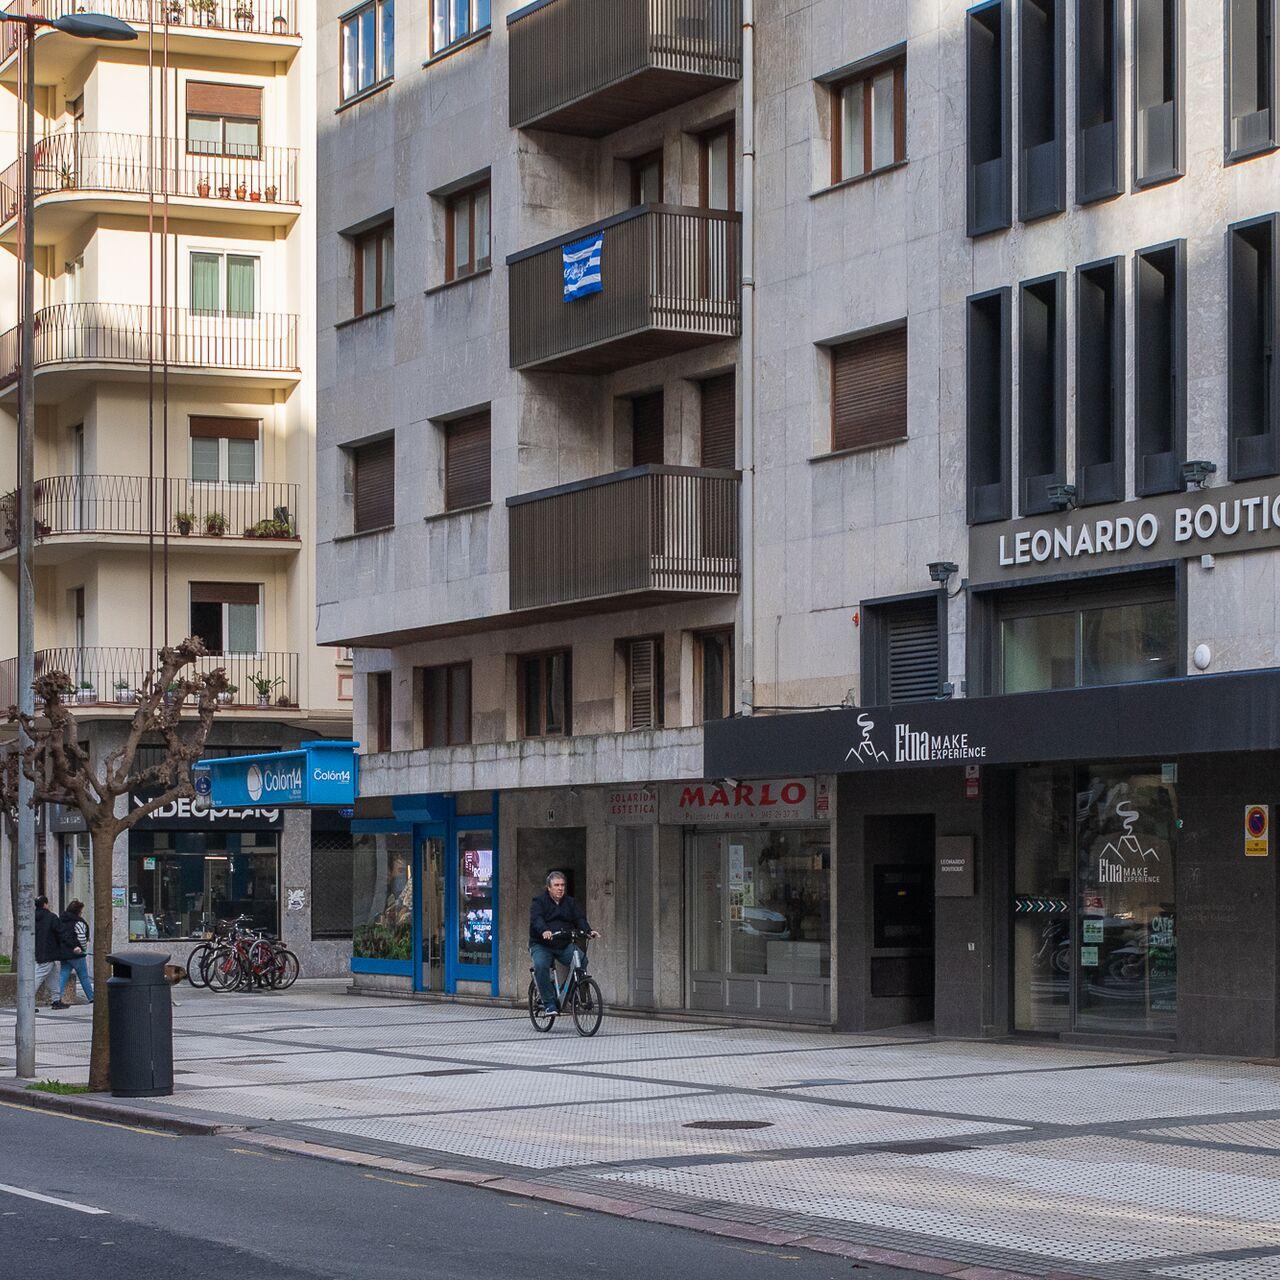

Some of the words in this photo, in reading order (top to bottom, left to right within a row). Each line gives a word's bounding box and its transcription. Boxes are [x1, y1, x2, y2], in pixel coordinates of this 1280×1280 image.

[999, 513, 1158, 566] LEONARDO
[895, 724, 929, 762] Etna
[931, 734, 968, 749] MAKE
[931, 747, 986, 760] EXPERIENCE
[264, 768, 302, 792] Colón14
[313, 770, 351, 781] Colón14
[610, 792, 657, 803] SOLARIUM
[679, 782, 807, 808] MARLO
[1099, 859, 1122, 882] Etna
[1123, 867, 1148, 876] MAKE
[1123, 875, 1160, 883] EXPERIENCE
